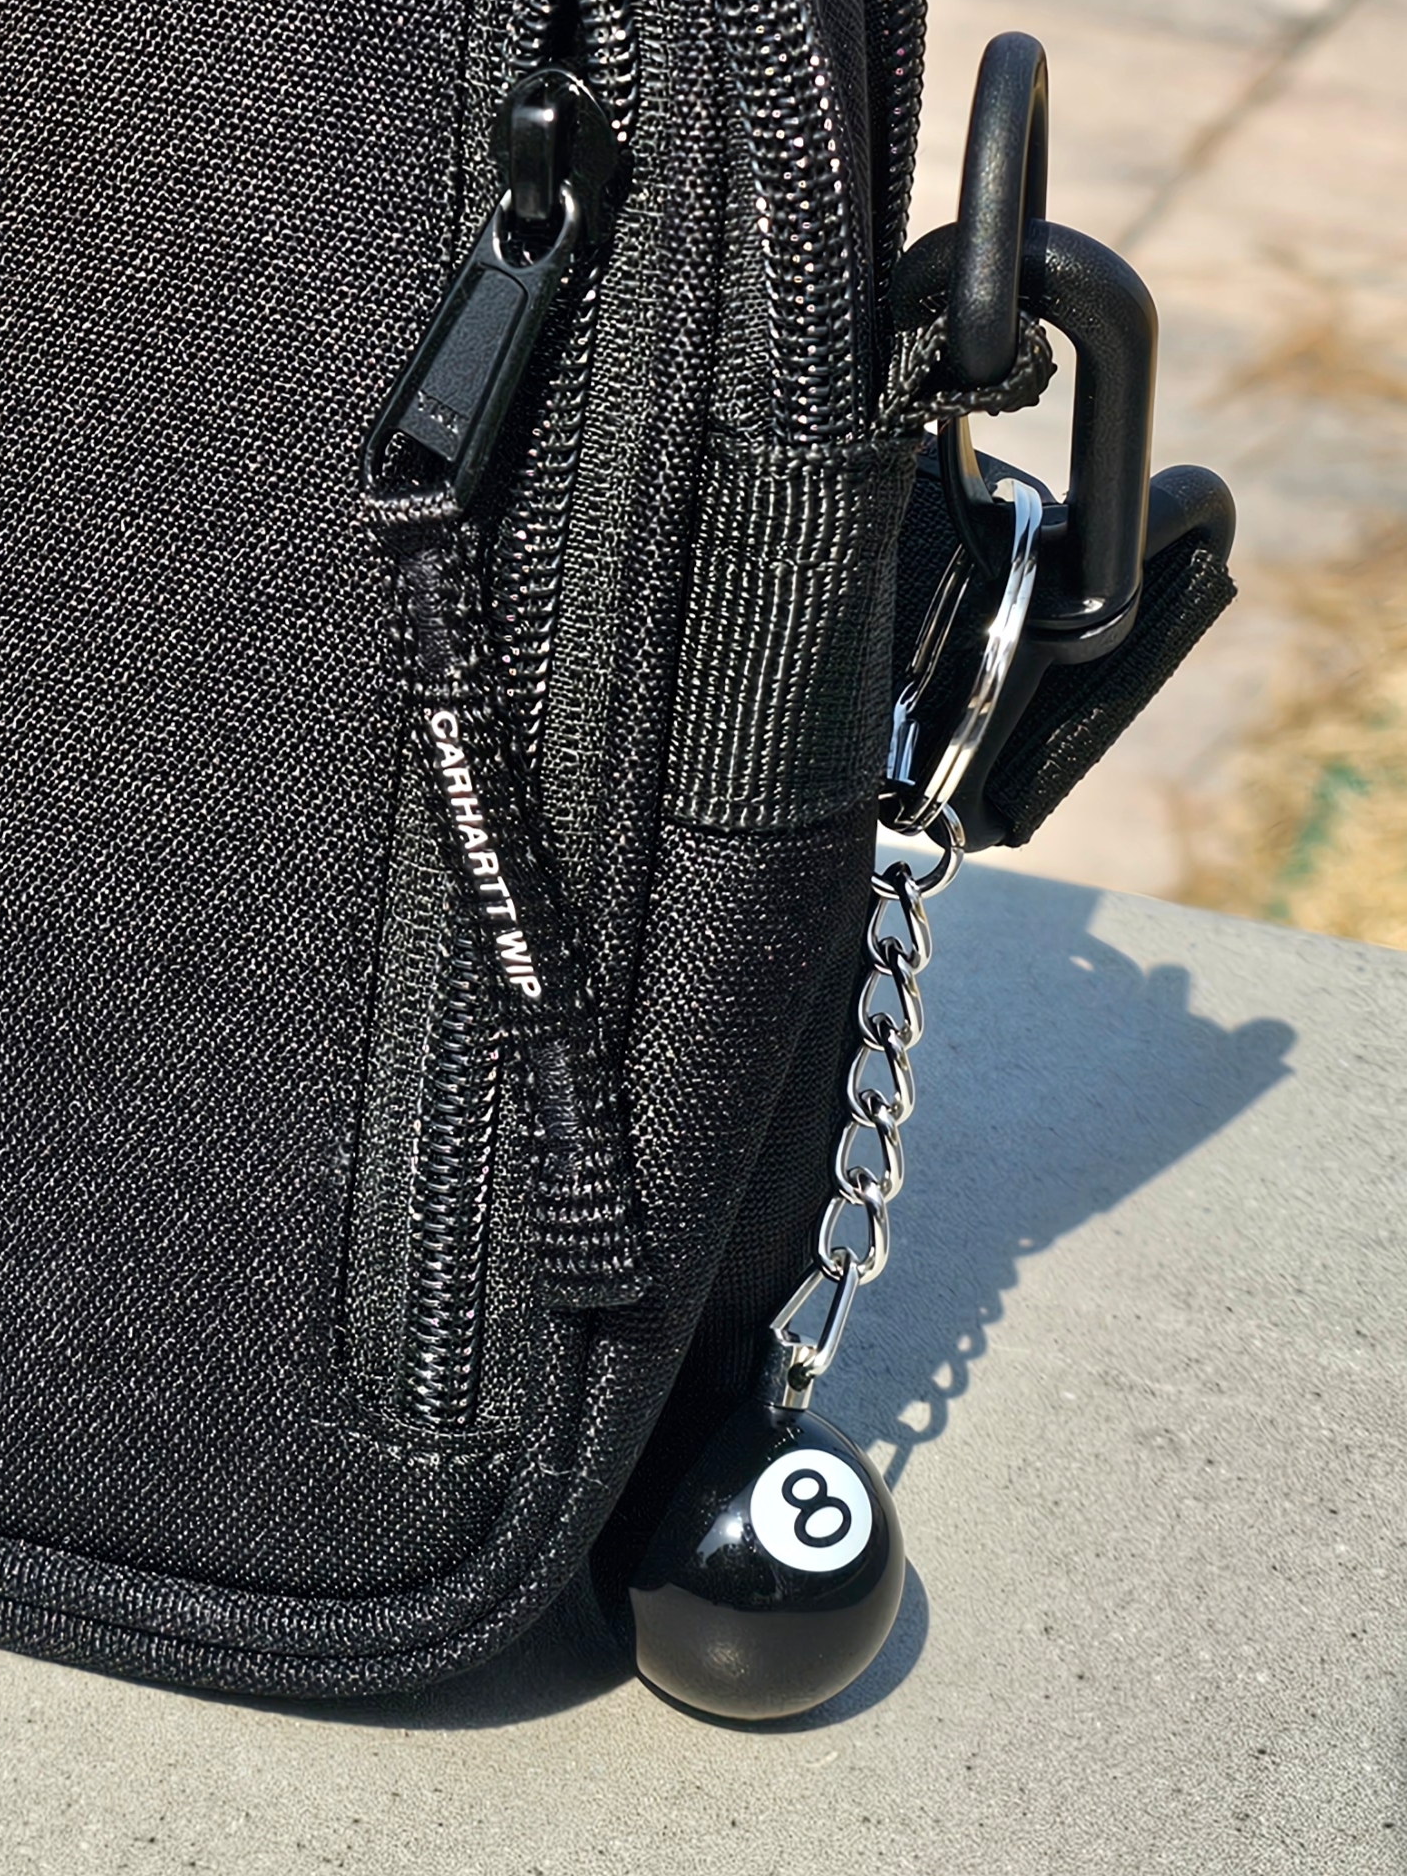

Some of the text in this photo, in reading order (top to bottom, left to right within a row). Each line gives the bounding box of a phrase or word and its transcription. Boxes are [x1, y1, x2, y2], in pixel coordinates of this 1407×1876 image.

[430, 710, 542, 998] CARHARTT WIP
[782, 1468, 852, 1548] 8
